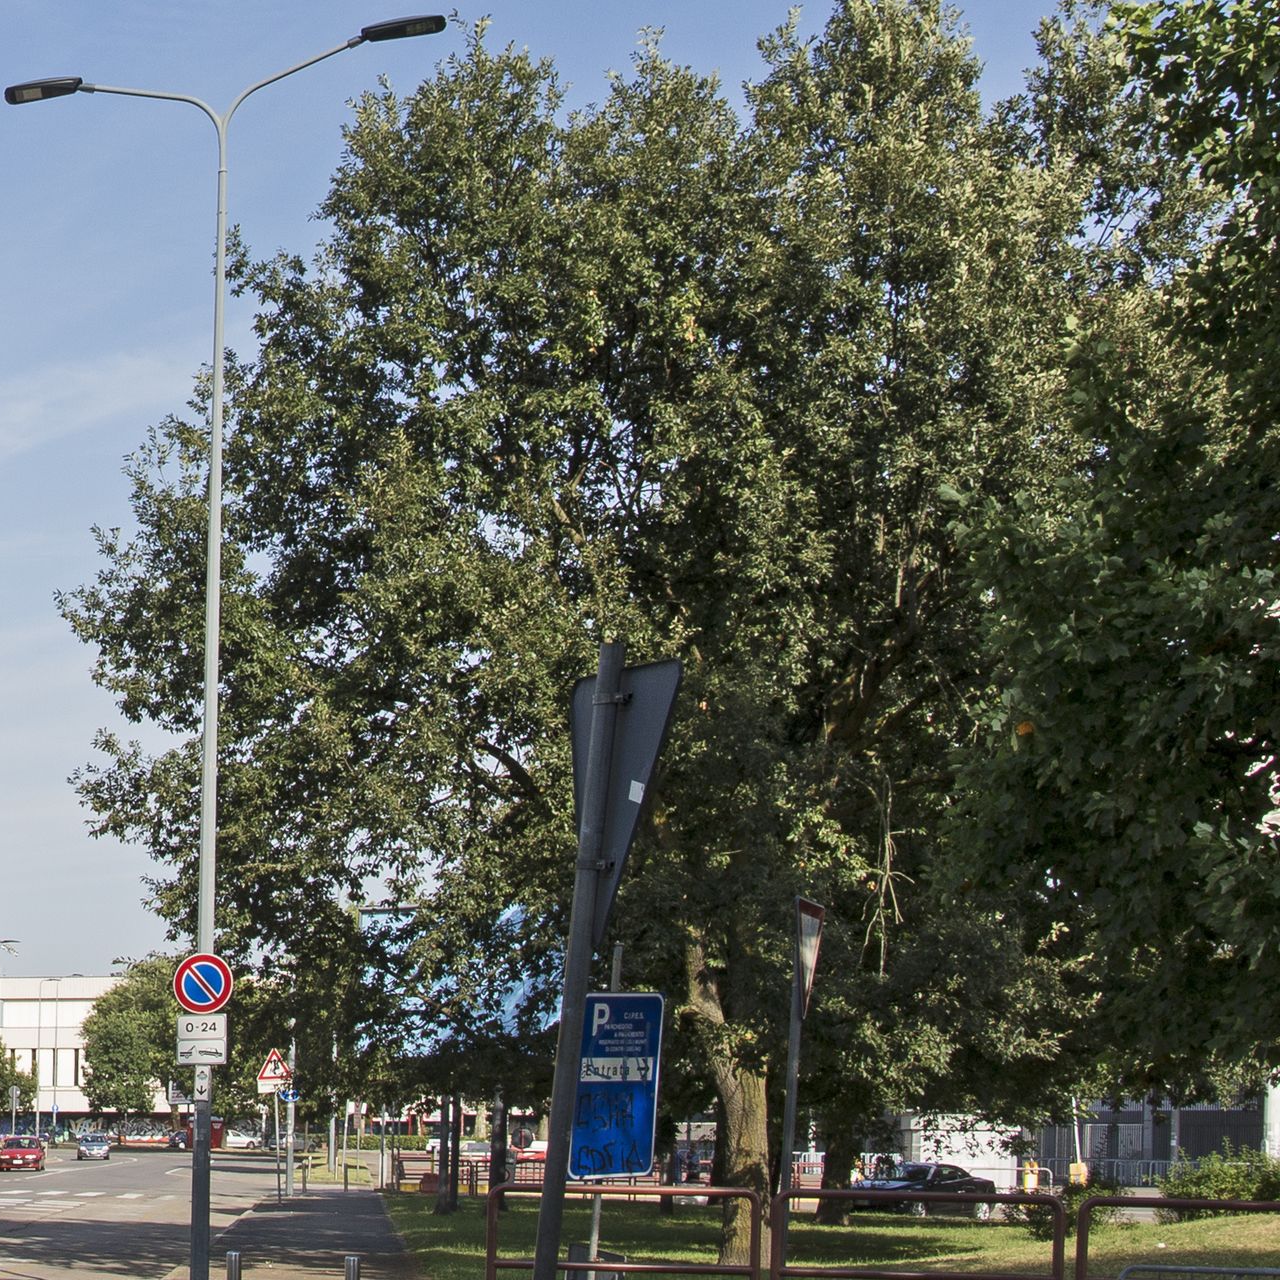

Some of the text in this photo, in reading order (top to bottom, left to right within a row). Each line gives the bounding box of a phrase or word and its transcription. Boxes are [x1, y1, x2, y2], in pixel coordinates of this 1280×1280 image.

[592, 1003, 610, 1037] P
[185, 1022, 217, 1032] 0-24
[585, 1064, 630, 1077] Entrata
